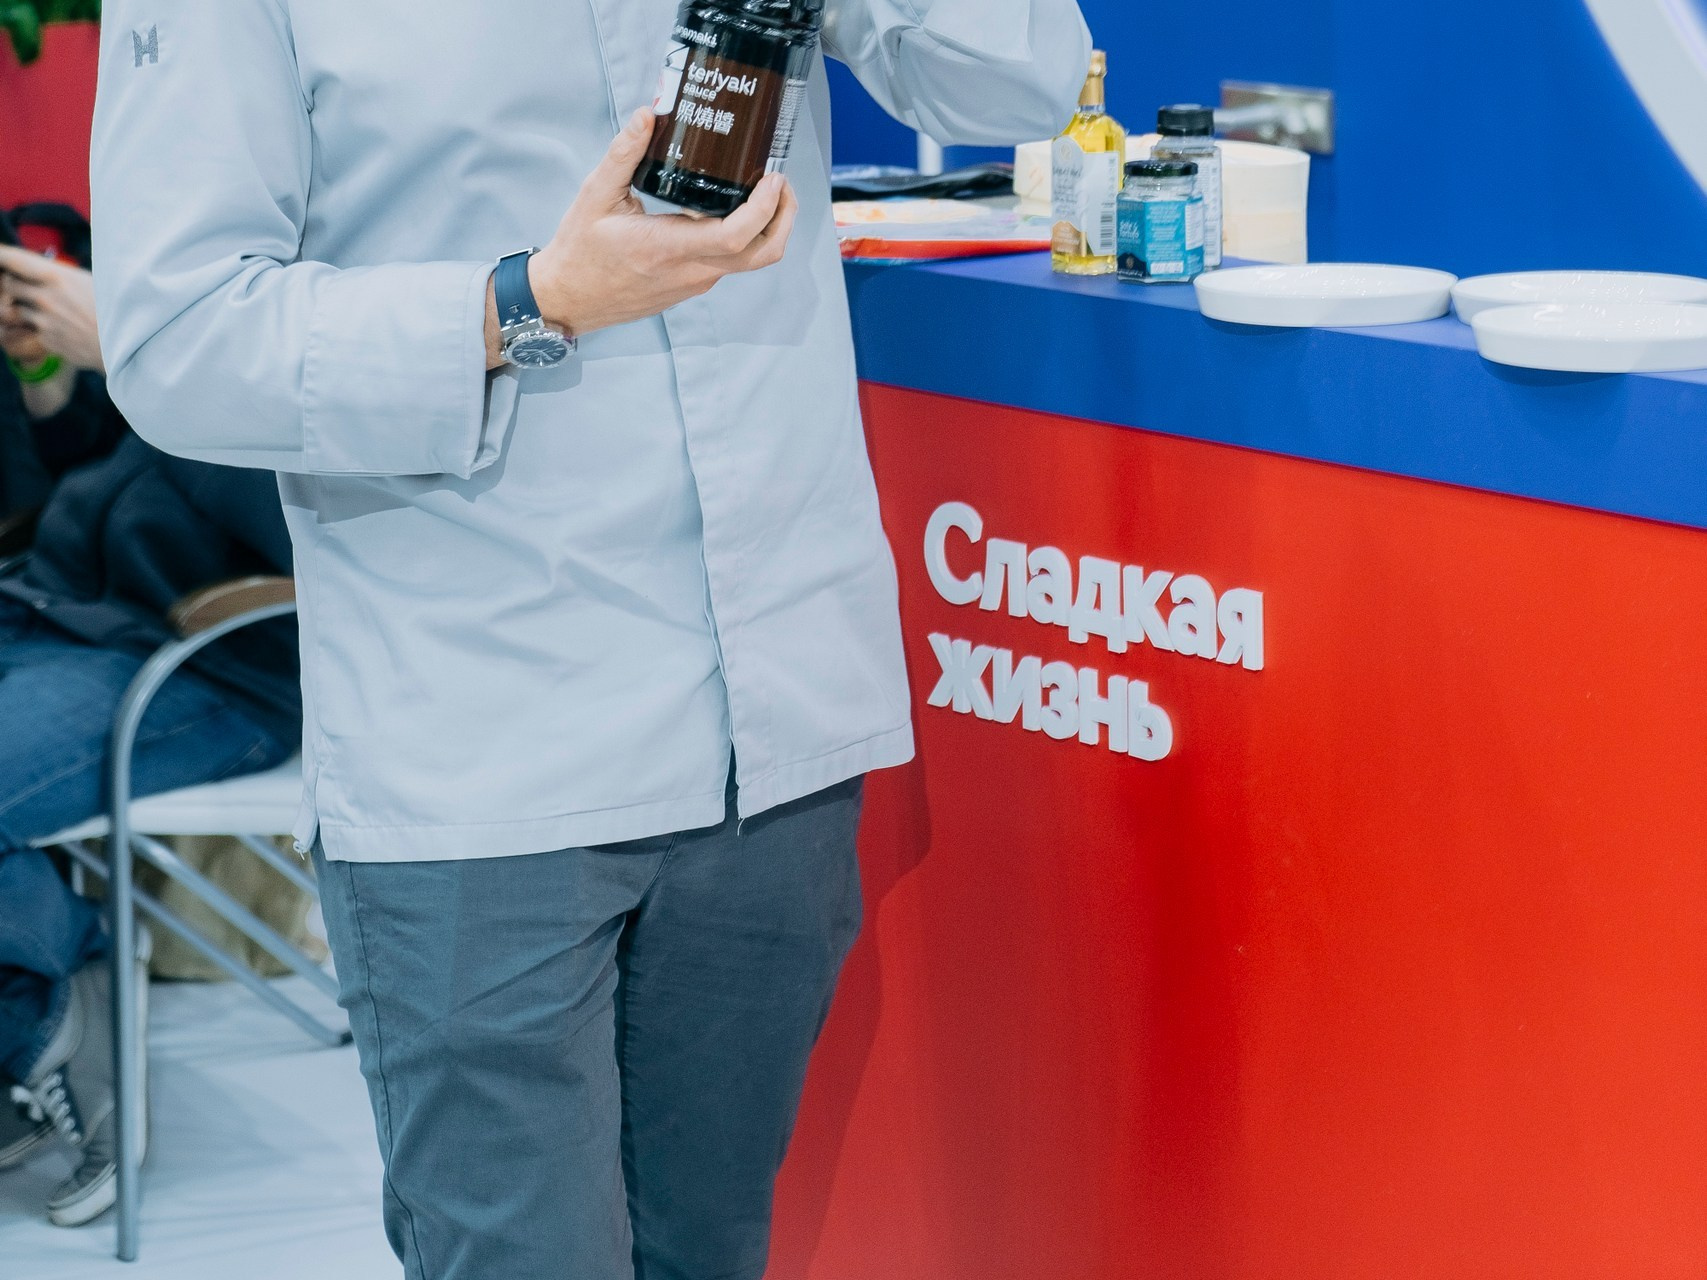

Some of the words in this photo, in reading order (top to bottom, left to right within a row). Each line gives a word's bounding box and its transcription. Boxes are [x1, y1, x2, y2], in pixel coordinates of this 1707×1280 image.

[682, 82, 717, 102] sauce
[688, 62, 757, 96] teriyaki
[924, 501, 1265, 671] Сладкая
[927, 631, 1174, 762] жизнь
